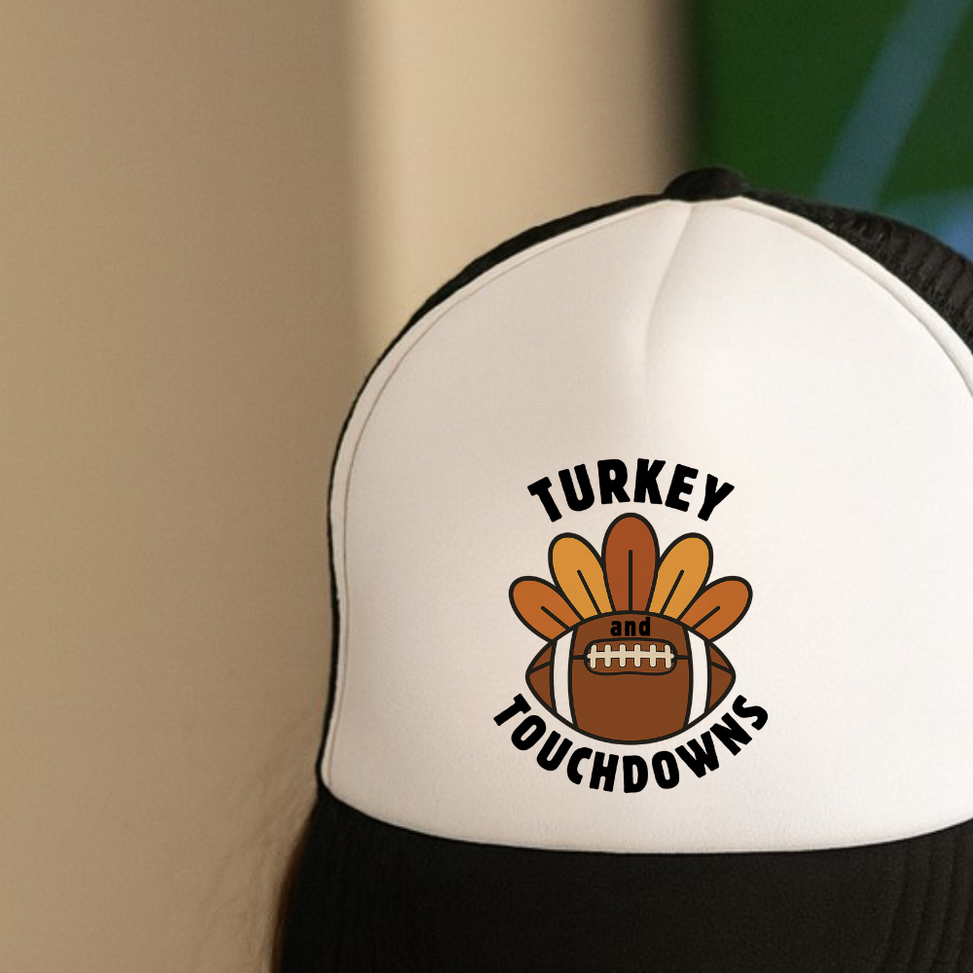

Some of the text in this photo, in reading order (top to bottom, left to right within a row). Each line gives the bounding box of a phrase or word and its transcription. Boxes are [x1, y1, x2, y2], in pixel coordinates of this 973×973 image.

[527, 458, 735, 522] TURKEY
[610, 617, 651, 636] and
[494, 693, 769, 793] TOUCHDOWNS
